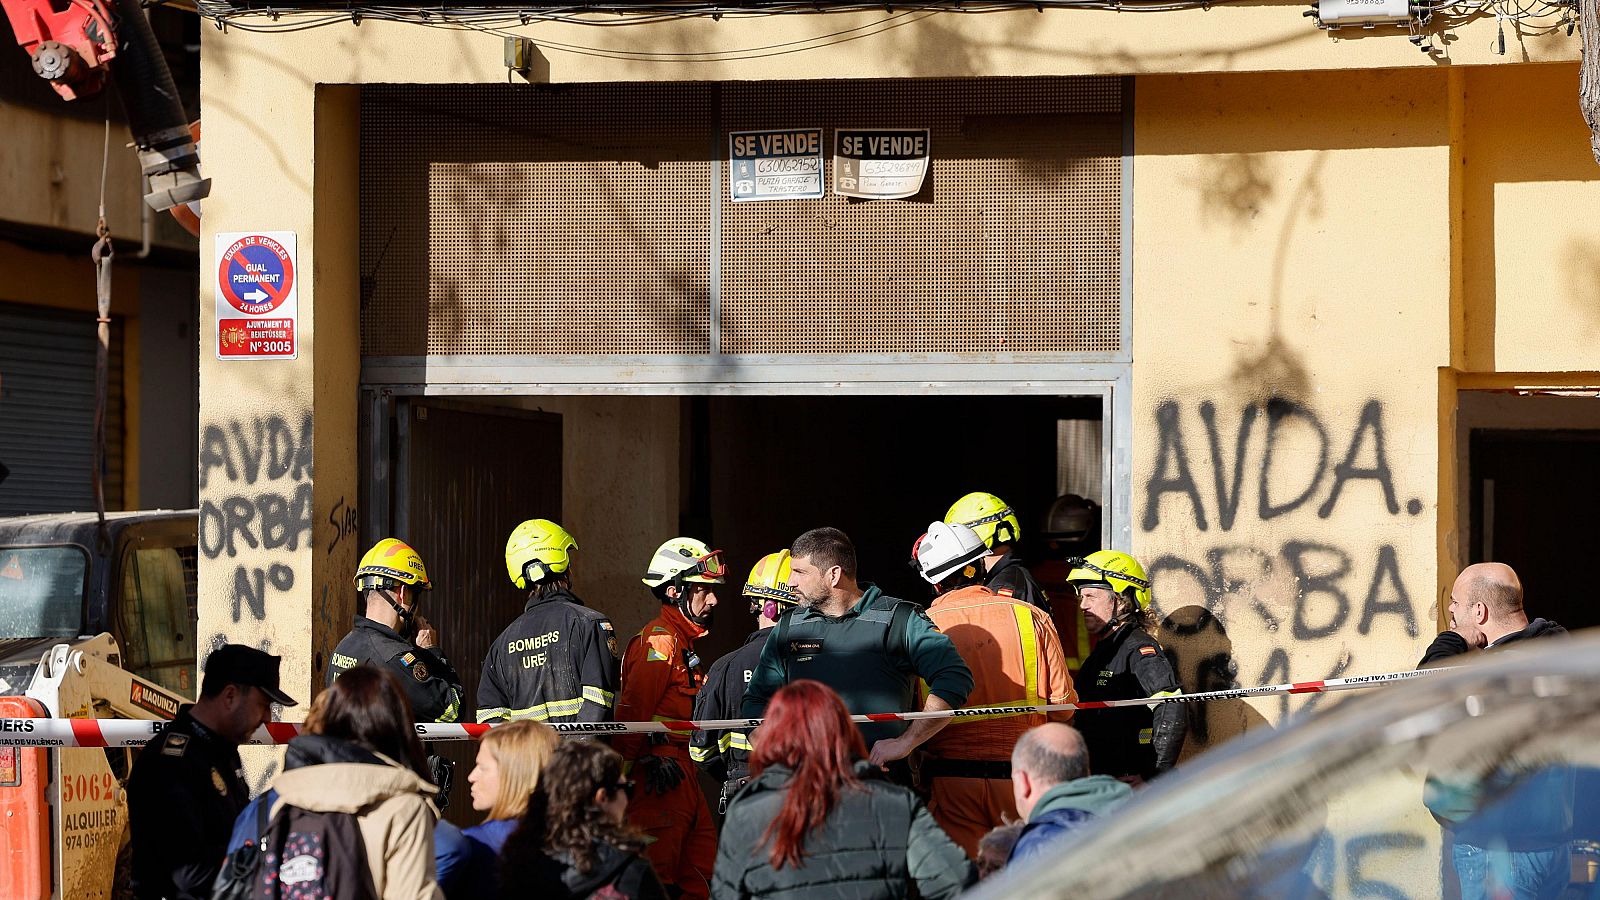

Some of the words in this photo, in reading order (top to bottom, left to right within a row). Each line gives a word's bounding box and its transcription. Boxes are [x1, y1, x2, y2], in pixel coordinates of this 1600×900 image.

[734, 135, 757, 157] SE
[759, 132, 819, 156] VENDE
[842, 136, 863, 155] SE
[868, 136, 924, 156] VENDE
[225, 241, 244, 261] EIXIDA
[245, 236, 255, 245] DE
[258, 236, 288, 261] VEHICLES
[233, 274, 280, 283] PERMANENT
[246, 263, 267, 273] GUAL
[240, 302, 248, 311] 24
[249, 302, 274, 313] HORES
[246, 320, 283, 329] AJUNTAMENT
[284, 320, 291, 328] DE
[200, 414, 312, 487] AVDA
[1142, 398, 1422, 531] AVDA.
[200, 482, 312, 559] ORBA
[233, 564, 294, 623] Nº
[1148, 540, 1419, 640] ORBA
[508, 630, 559, 654] BOMBERS
[332, 652, 357, 669] BOMBERS
[142, 687, 178, 715] MAQUINZA
[27, 737, 64, 746] VALÈNCIA
[63, 772, 113, 802] 5062
[64, 808, 117, 833] ALQUILER
[65, 834, 82, 851] 974
